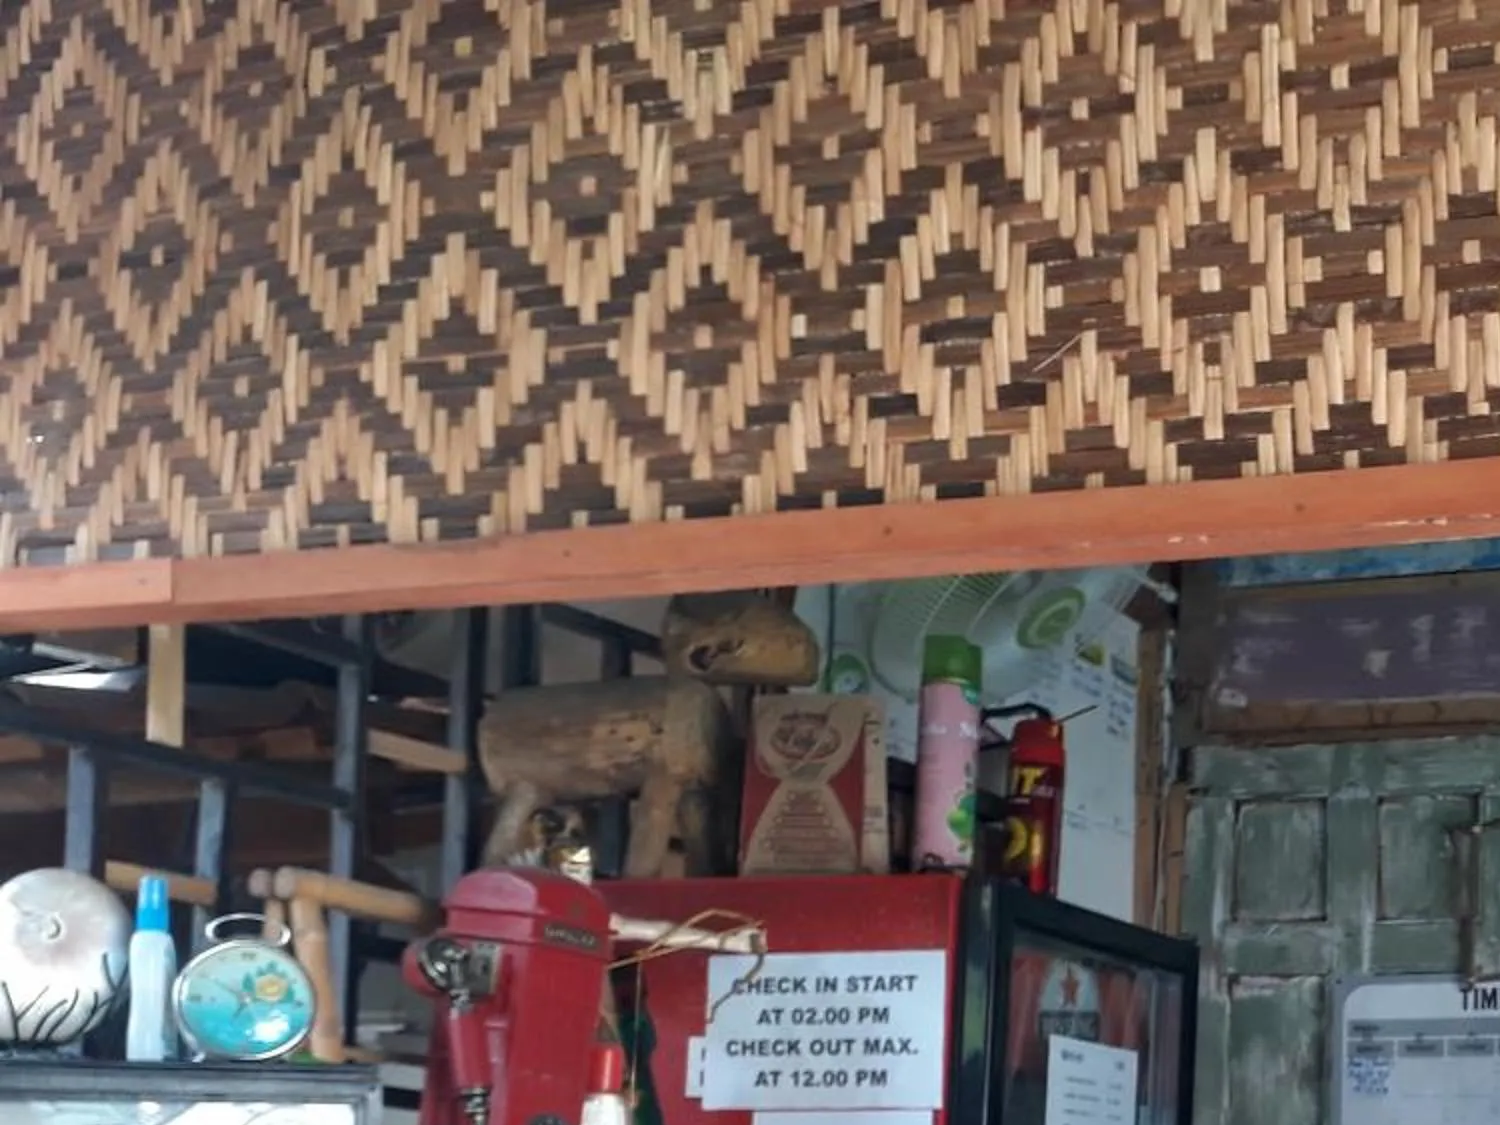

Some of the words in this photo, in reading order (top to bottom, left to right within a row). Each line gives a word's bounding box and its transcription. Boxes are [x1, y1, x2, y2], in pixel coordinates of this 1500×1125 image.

[732, 976, 807, 994] CHECK
[815, 976, 838, 993] IN
[846, 975, 918, 992] START
[757, 1009, 784, 1025] AT
[791, 1008, 850, 1025] 02.00
[858, 1007, 890, 1024] PM
[725, 1039, 801, 1057] CHECK
[809, 1038, 856, 1056] OUT
[863, 1037, 918, 1055] MAX.
[754, 1070, 781, 1088] AT
[791, 1069, 848, 1087] 12.00
[855, 1069, 888, 1087] PM
